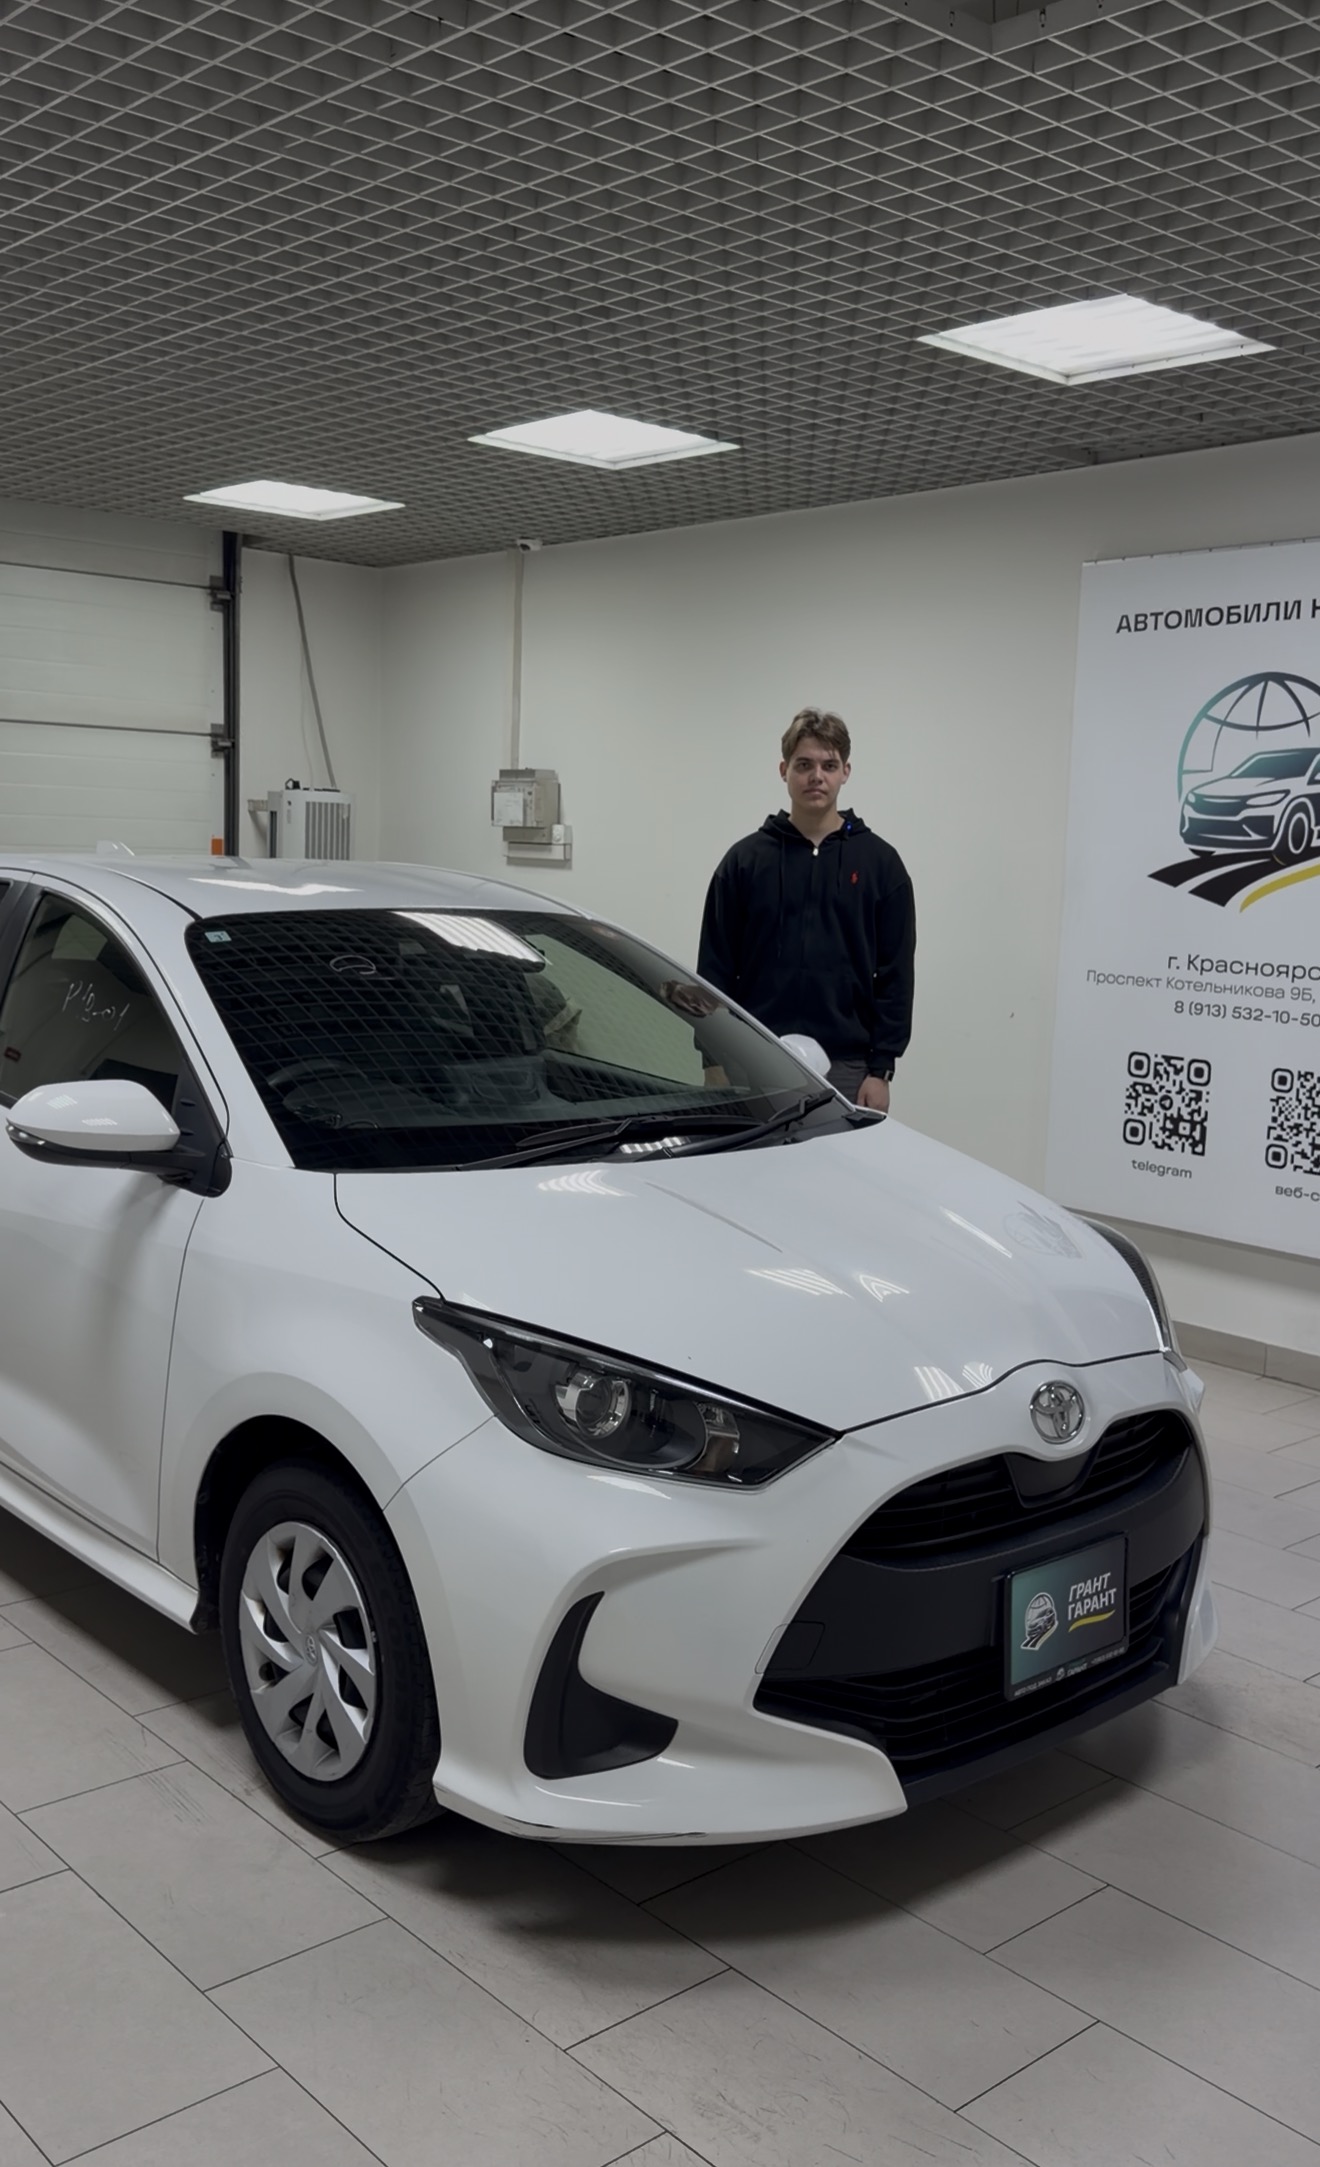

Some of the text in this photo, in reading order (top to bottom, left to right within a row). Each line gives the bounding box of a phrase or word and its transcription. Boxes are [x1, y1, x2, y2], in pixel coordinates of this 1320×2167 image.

[1116, 600, 1302, 634] АВТОМОБИЛИ
[1167, 953, 1320, 983] г. Красноярс
[1087, 969, 1162, 988] Проспект
[1166, 976, 1285, 1000] Котельникова
[1173, 1000, 1320, 1028] 8 (913) 532-10-50
[1131, 1159, 1193, 1179] telegram
[1275, 1185, 1320, 1202] веб-с
[1068, 1572, 1111, 1602] ГРАНТ
[1067, 1588, 1117, 1621] ГАРАНТ
